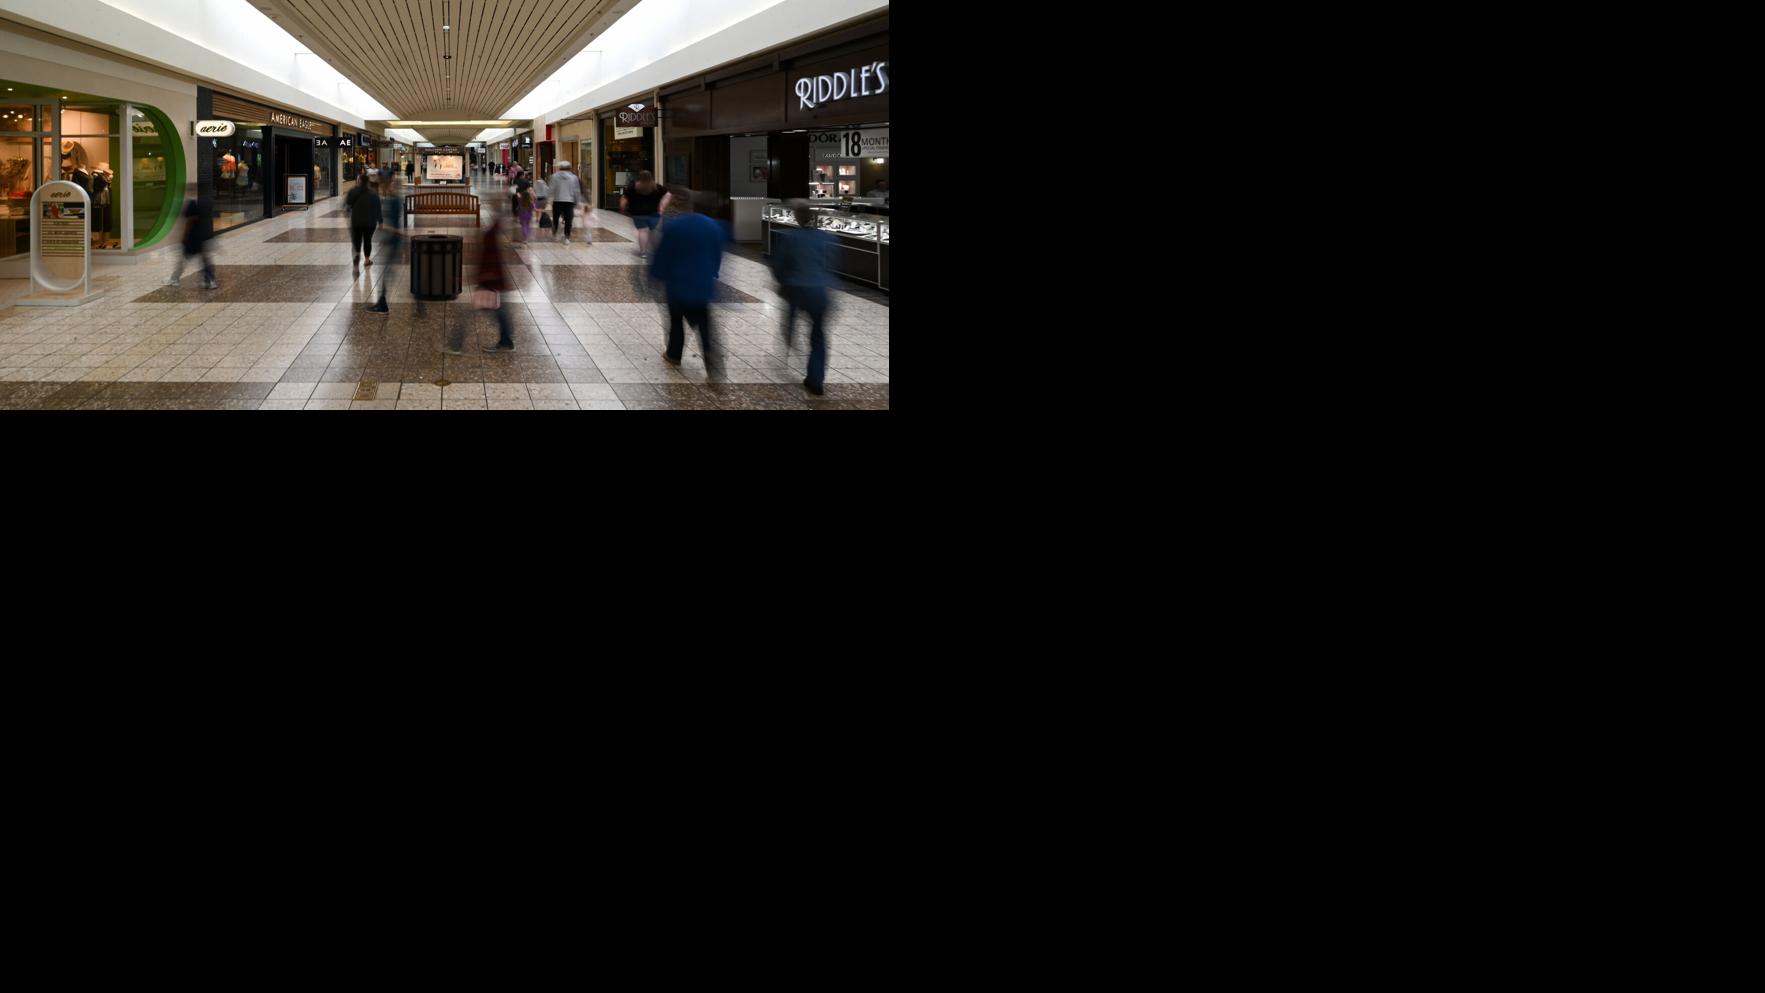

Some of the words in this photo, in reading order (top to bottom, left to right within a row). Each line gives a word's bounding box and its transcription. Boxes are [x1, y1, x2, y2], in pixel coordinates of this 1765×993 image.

[795, 62, 887, 110] RIDDLE'S
[271, 112, 298, 126] AMERICAN
[200, 123, 227, 133] aerie
[808, 131, 841, 143] DÔR
[843, 131, 862, 157] 18
